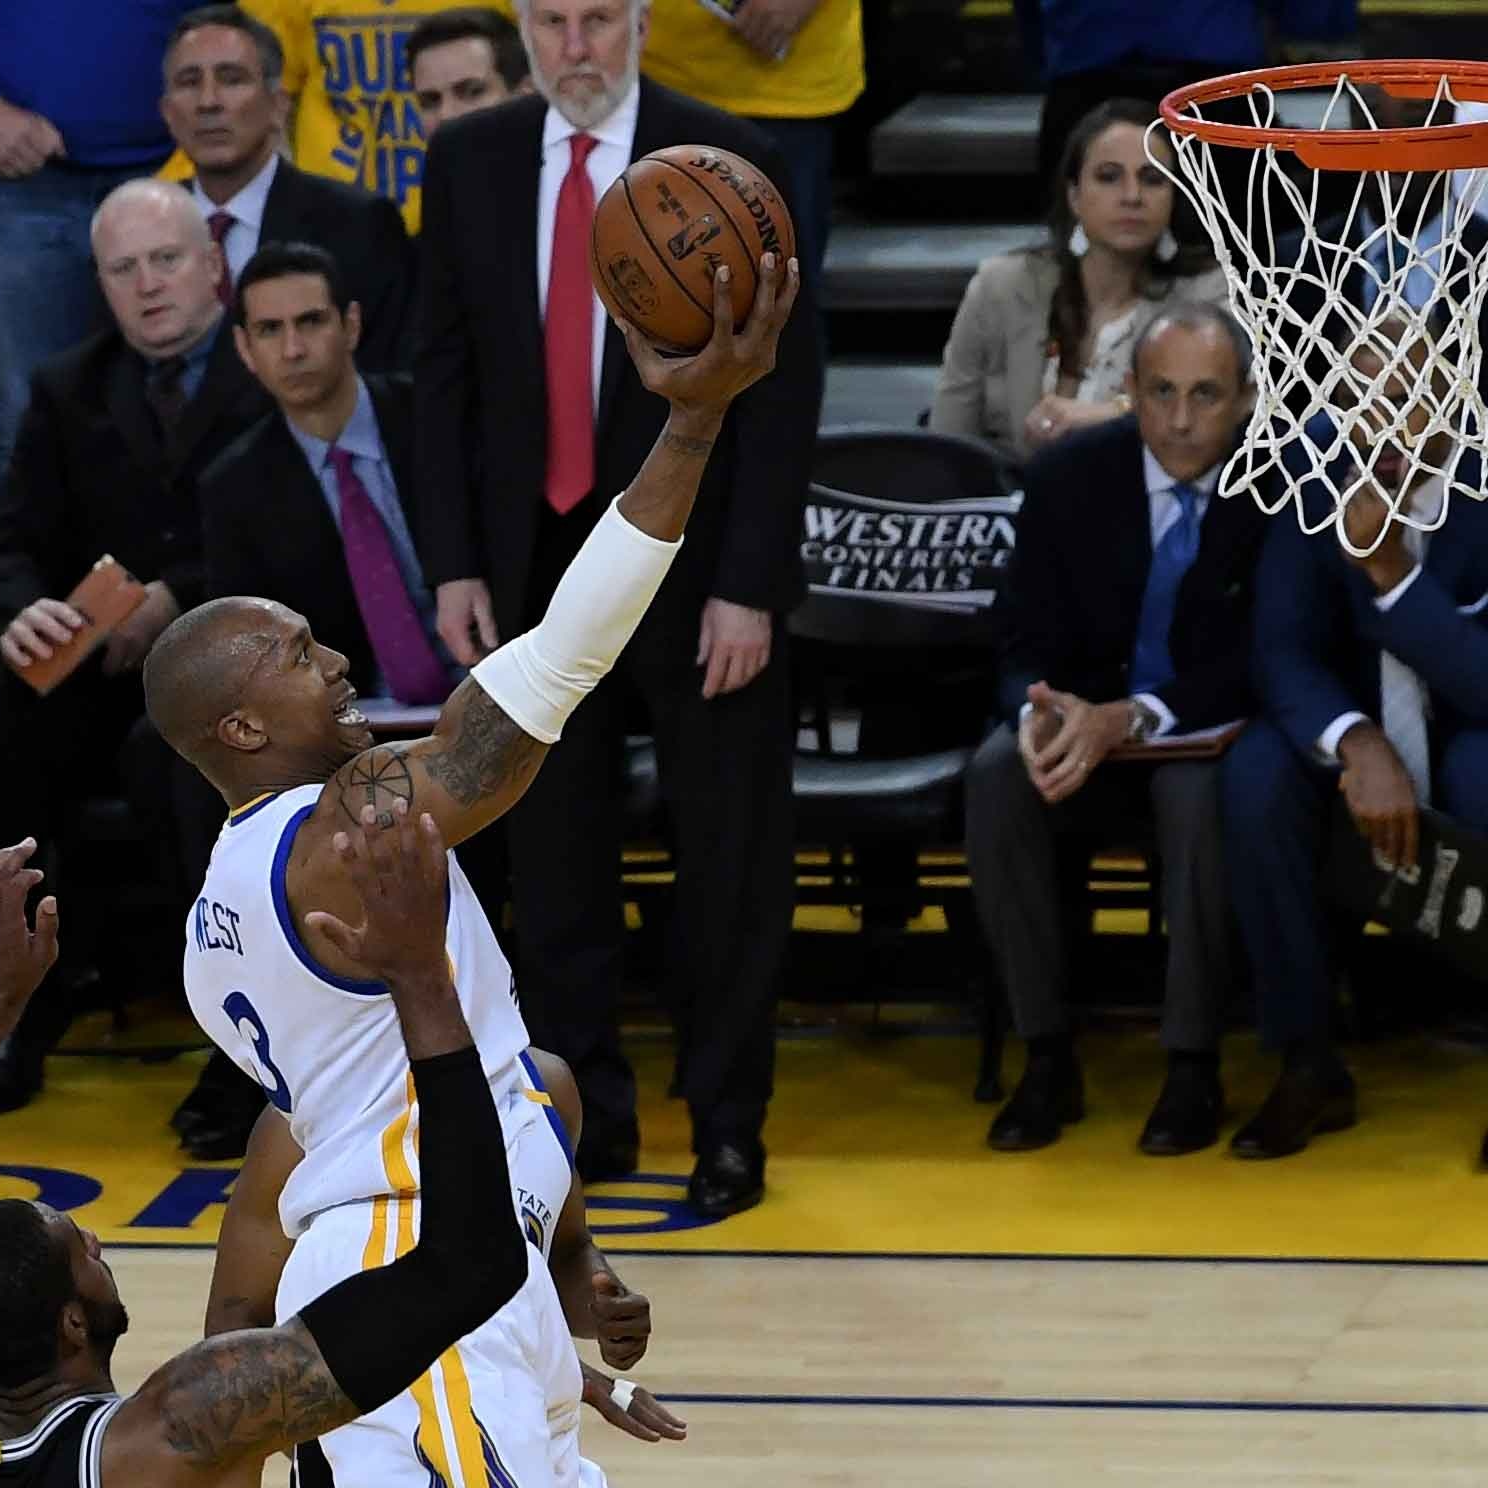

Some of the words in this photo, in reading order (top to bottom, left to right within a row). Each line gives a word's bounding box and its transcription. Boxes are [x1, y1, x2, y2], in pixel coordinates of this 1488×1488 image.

[316, 31, 415, 93] DUB
[804, 504, 1016, 549] WESTERN
[800, 541, 1009, 569] CONFERENCE
[827, 564, 973, 591] FINALS
[221, 990, 293, 1114] 3
[515, 1187, 553, 1226] TATE
